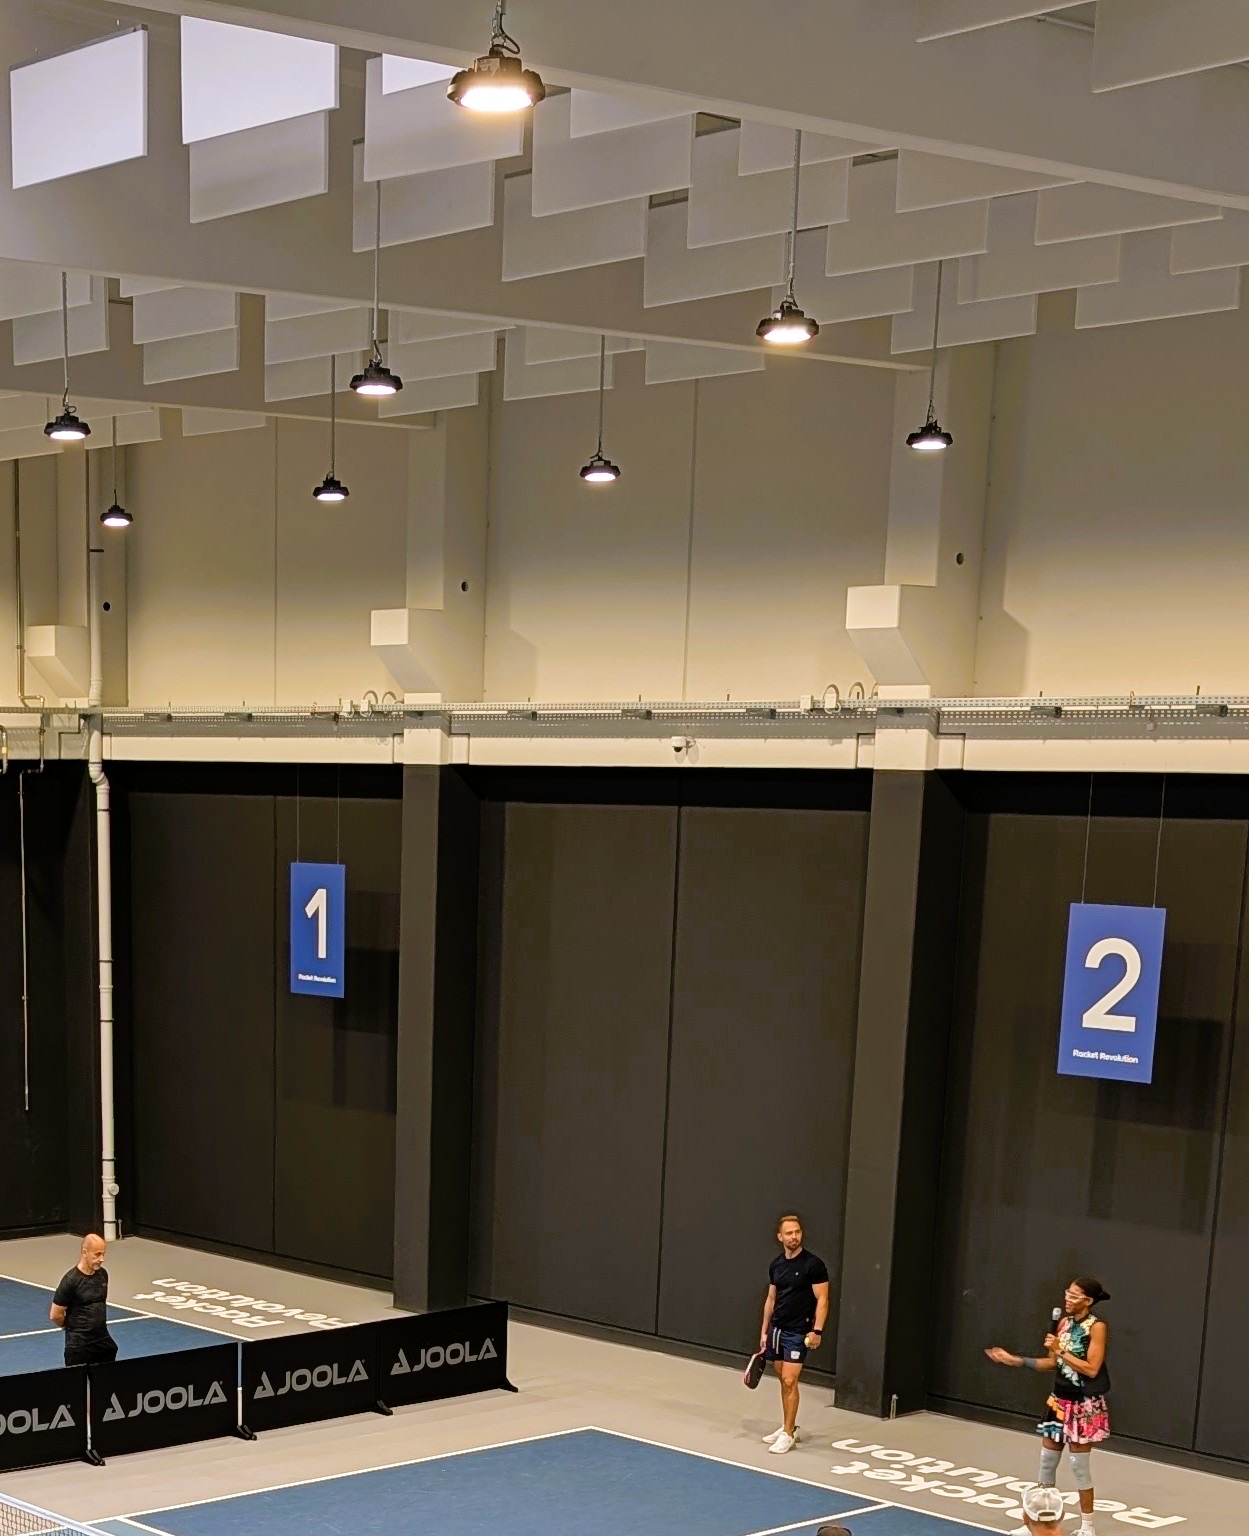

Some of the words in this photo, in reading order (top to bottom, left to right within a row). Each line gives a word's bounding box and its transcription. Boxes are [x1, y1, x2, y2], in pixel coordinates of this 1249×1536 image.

[304, 888, 327, 959] 1
[1082, 937, 1141, 1032] 2
[1099, 1052, 1139, 1064] Revolution
[133, 1291, 285, 1328] Racket
[152, 1277, 359, 1330] Revolution
[412, 1337, 498, 1372] JOOLA
[276, 1359, 369, 1396] JOOLA
[127, 1380, 228, 1418] JOOLA
